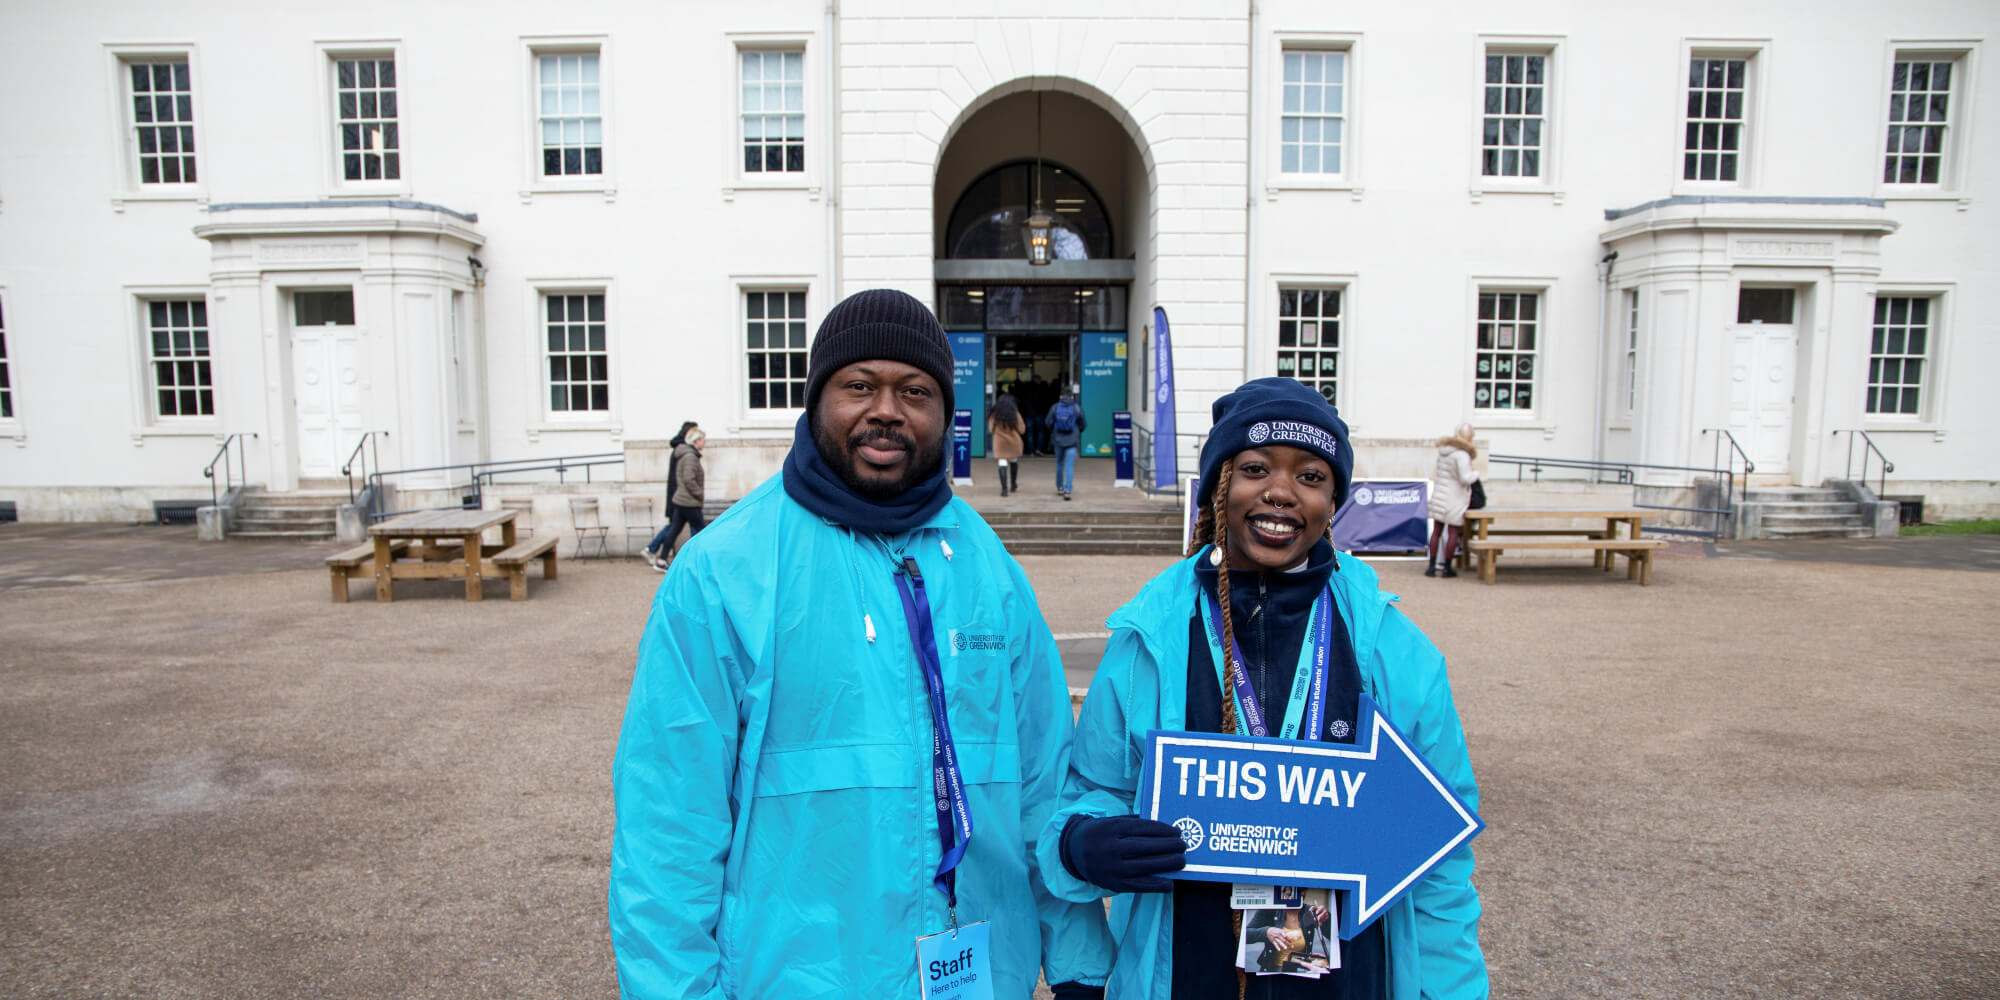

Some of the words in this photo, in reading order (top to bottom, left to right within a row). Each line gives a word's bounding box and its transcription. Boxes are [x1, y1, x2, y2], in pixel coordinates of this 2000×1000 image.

[1271, 421, 1333, 443] UNIVERSITY
[1271, 430, 1336, 457] GREENWICH
[969, 641, 1006, 650] GREENWICH
[1232, 660, 1246, 687] Visitor
[1309, 699, 1320, 741] greenwich
[945, 744, 953, 765] union
[1172, 756, 1267, 801] THIS
[1277, 764, 1367, 808] WAY
[1209, 822, 1282, 838] UNIVERSITY
[1282, 827, 1299, 840] OF
[1208, 835, 1299, 856] GREENWICH
[929, 947, 973, 981] Staff
[931, 983, 950, 997] Here
[950, 979, 959, 989] to
[960, 972, 977, 985] help
